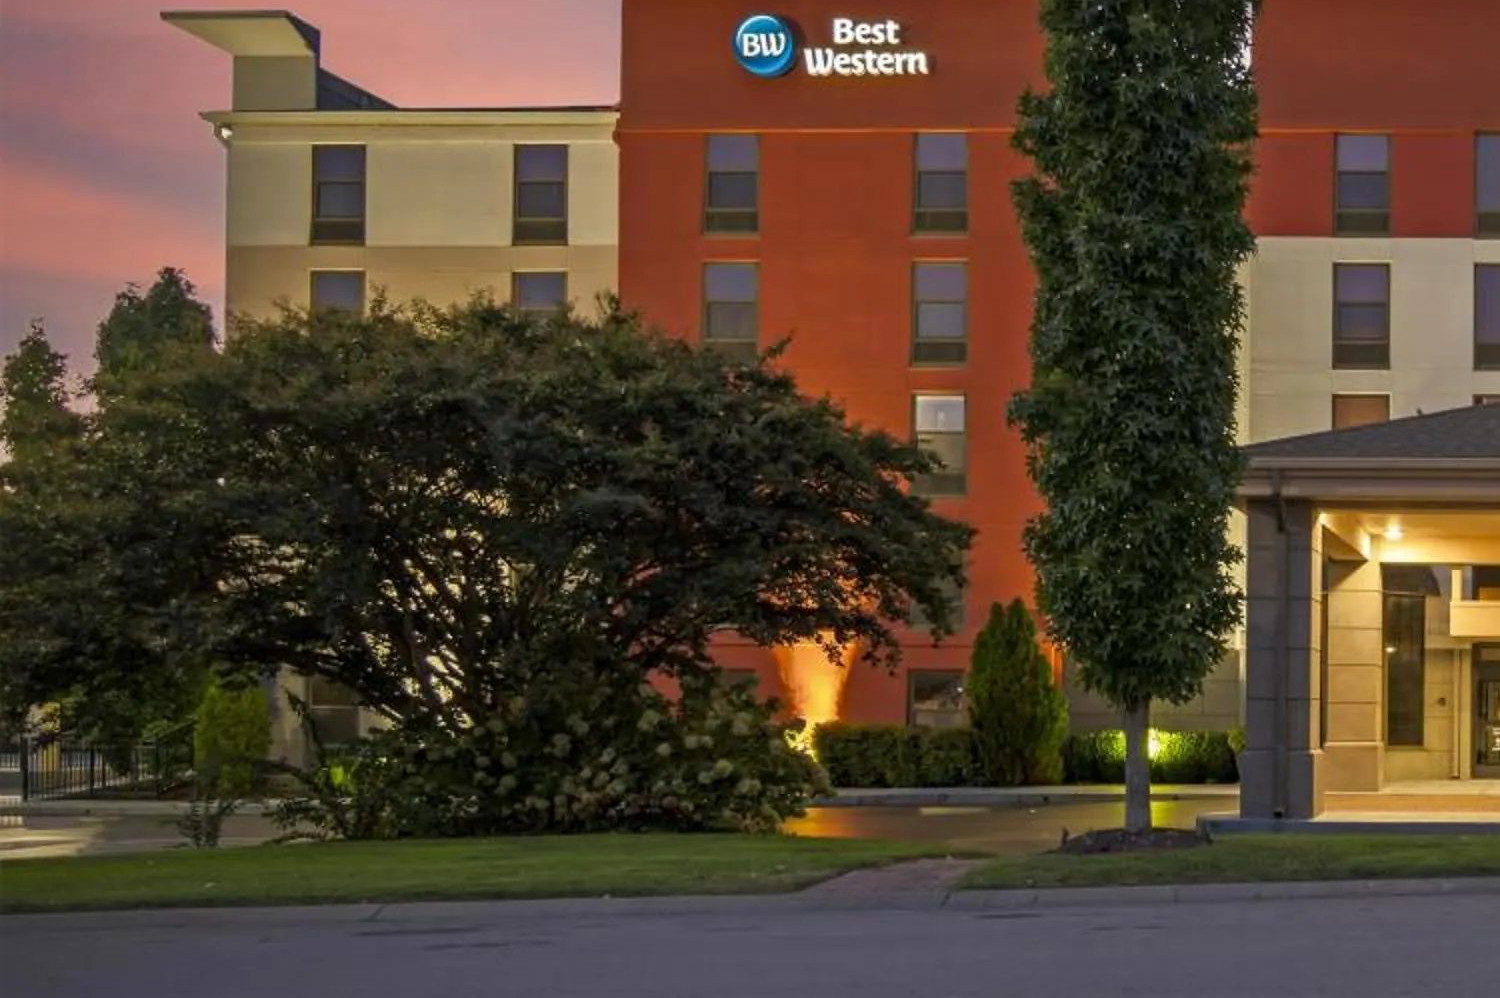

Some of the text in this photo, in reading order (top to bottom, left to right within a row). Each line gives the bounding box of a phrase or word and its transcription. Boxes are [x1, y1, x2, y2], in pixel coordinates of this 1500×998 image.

[832, 17, 900, 44] Best
[742, 33, 786, 57] BW
[804, 48, 929, 76] Western
